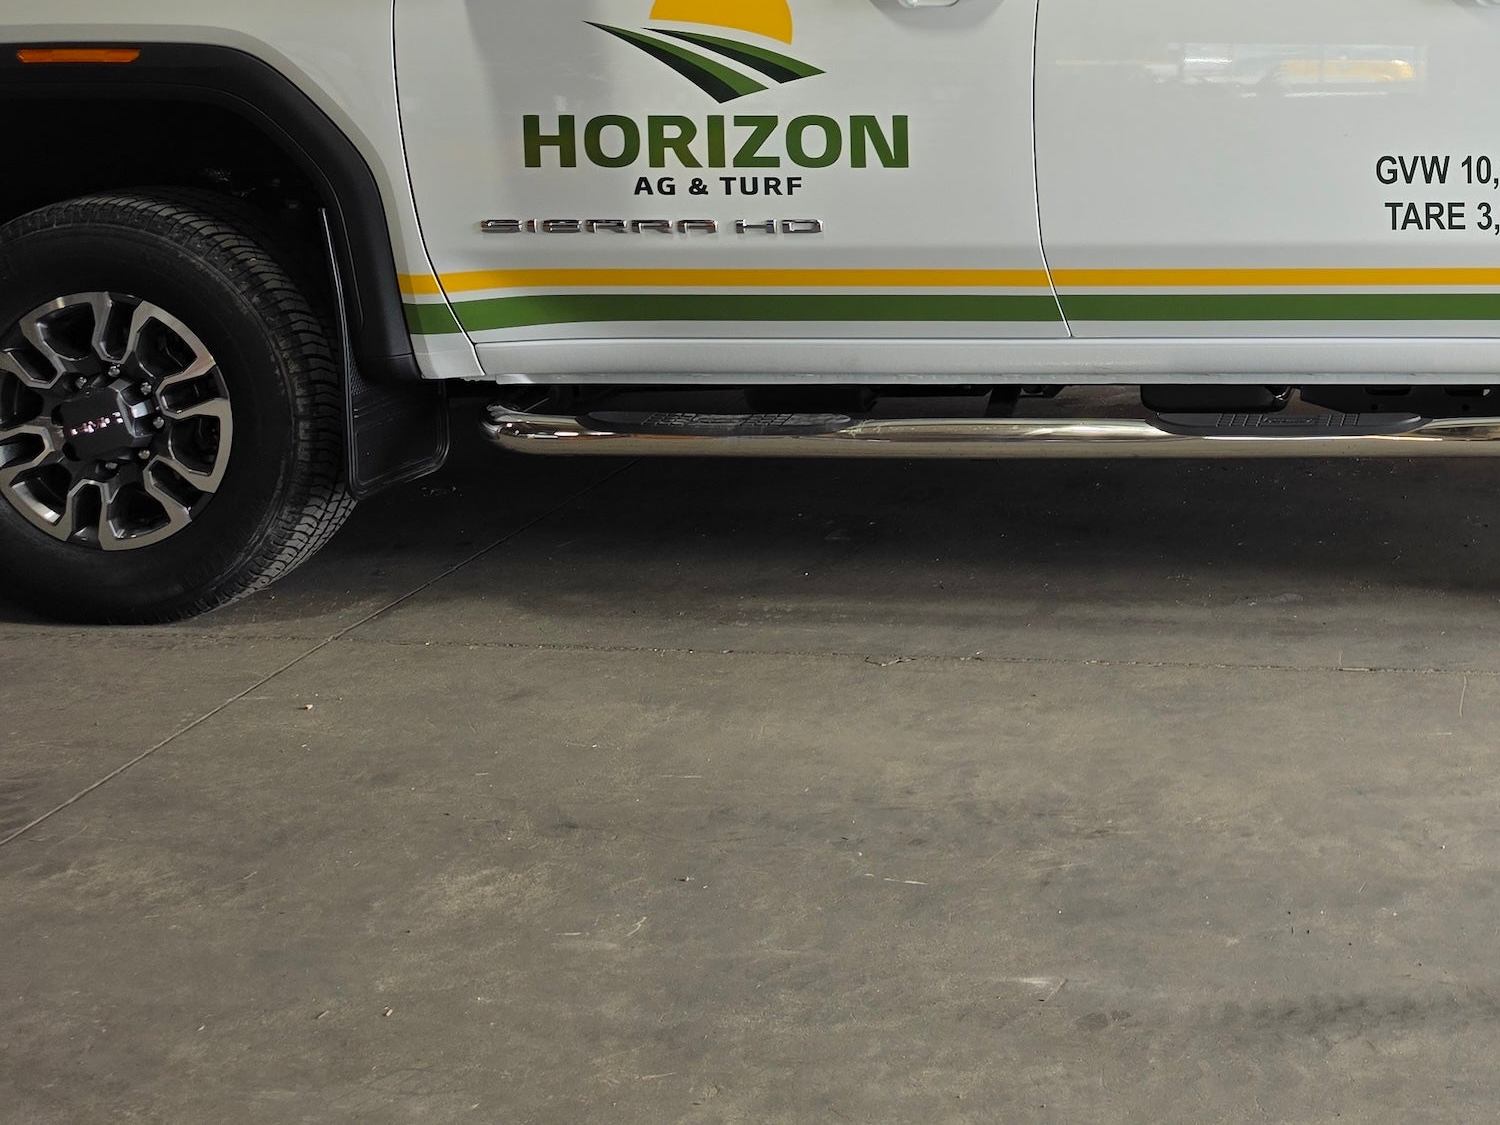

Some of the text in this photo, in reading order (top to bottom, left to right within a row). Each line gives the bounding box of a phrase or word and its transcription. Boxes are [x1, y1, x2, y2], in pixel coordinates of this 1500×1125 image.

[522, 114, 910, 169] HORIZON
[1375, 155, 1451, 185] GVW
[633, 176, 803, 196] AG & TURF
[480, 218, 825, 235] SIERRA HD
[1384, 202, 1467, 231] TARE
